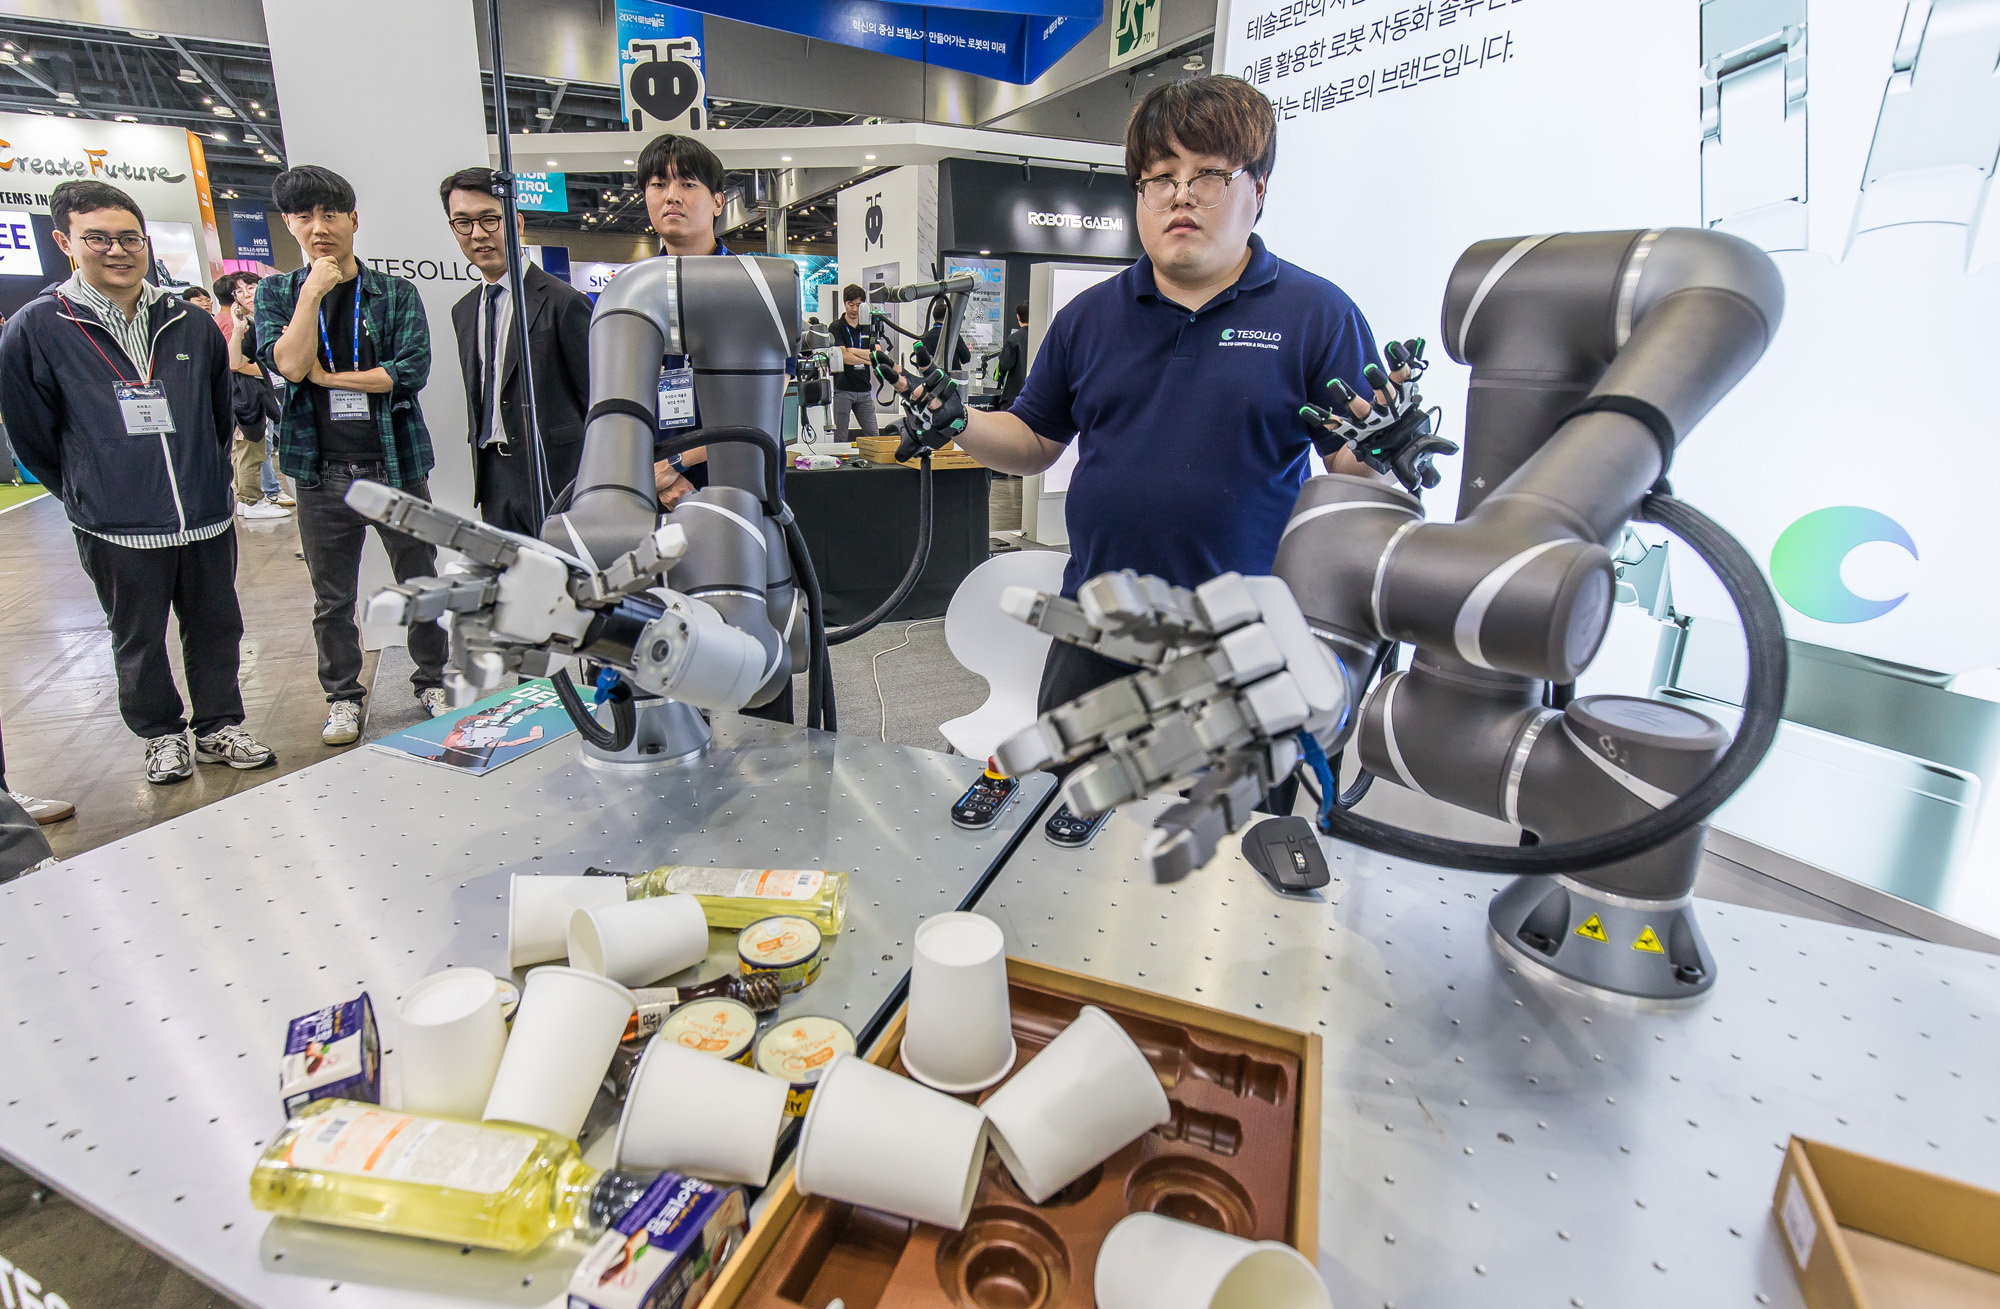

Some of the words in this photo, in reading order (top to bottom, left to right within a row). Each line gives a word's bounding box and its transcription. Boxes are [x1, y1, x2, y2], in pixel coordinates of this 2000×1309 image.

[852, 20, 877, 34] 혁신의
[878, 24, 895, 37] 중심
[929, 32, 966, 47] 만들어가는
[967, 38, 990, 51] 로봇의
[991, 42, 1006, 54] 미래
[1247, 0, 1326, 41] 테솔로만의
[1243, 56, 1273, 85] 이를
[1275, 38, 1326, 79] 활용한
[1327, 25, 1366, 60] 로봇
[1369, 1, 1434, 45] 자동화
[1303, 70, 1375, 113] 테솔로의
[1378, 30, 1514, 93] 브랜드입니다.
[0, 139, 84, 176] Create
[82, 148, 187, 184] Future
[516, 180, 553, 193] TROL
[1027, 211, 1083, 228] ROBOTIS
[1083, 216, 1123, 231] GAEMI
[1237, 330, 1282, 341] TESOLLO
